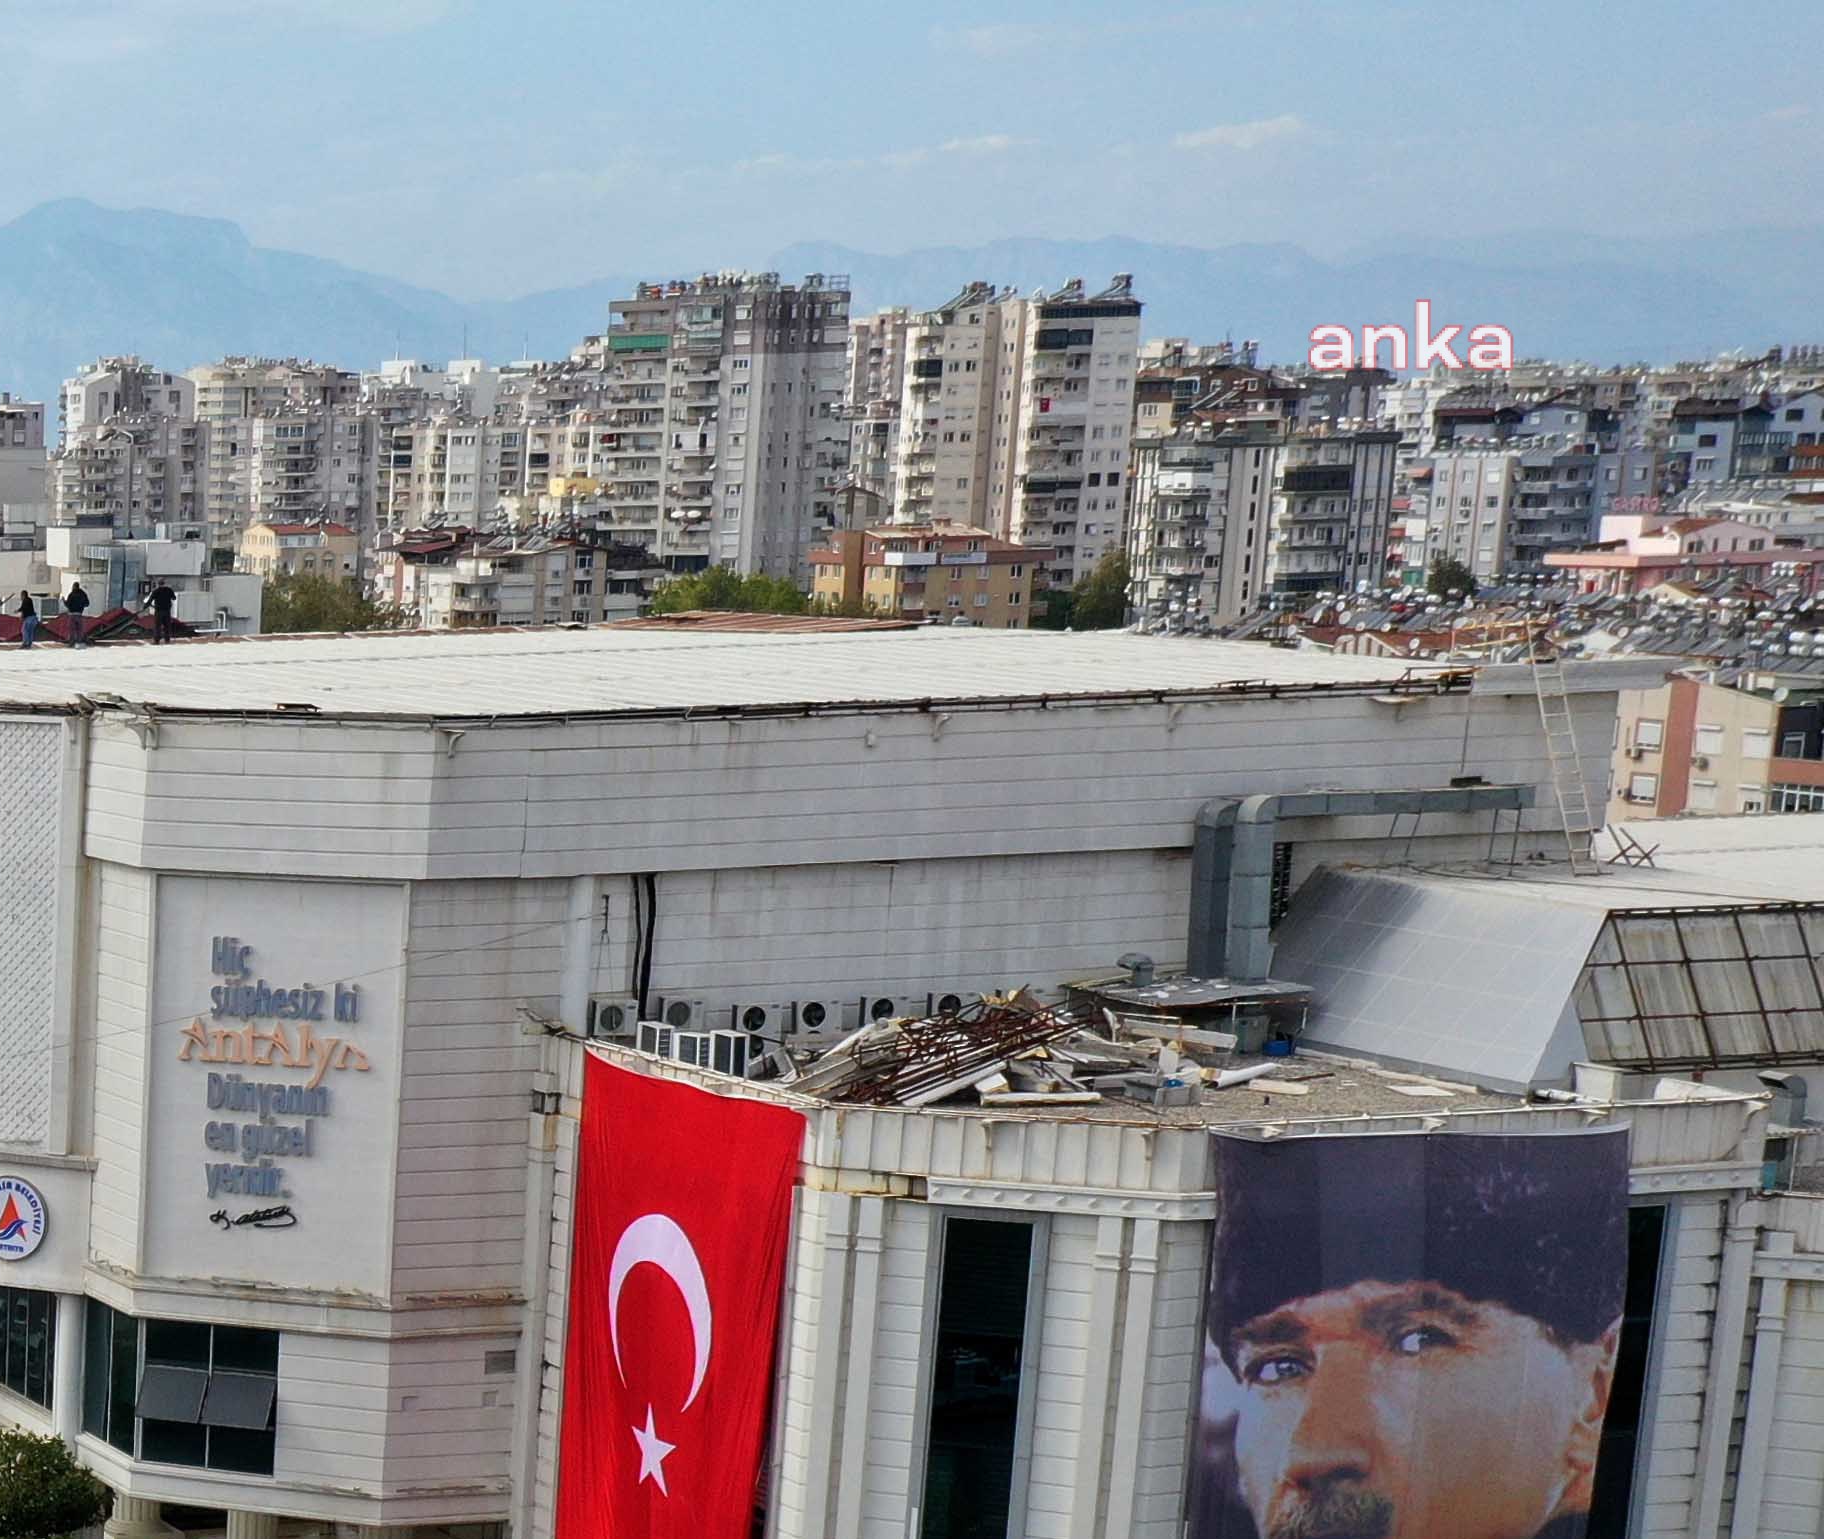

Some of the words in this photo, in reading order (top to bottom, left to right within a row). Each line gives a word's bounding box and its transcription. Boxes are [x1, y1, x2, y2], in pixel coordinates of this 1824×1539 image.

[211, 936, 252, 978] Hiç
[210, 978, 326, 1022] şüphesiz
[334, 982, 362, 1022] ki
[206, 1071, 332, 1125] Dünyanın
[204, 1120, 236, 1151] en
[241, 1118, 314, 1164] güzel
